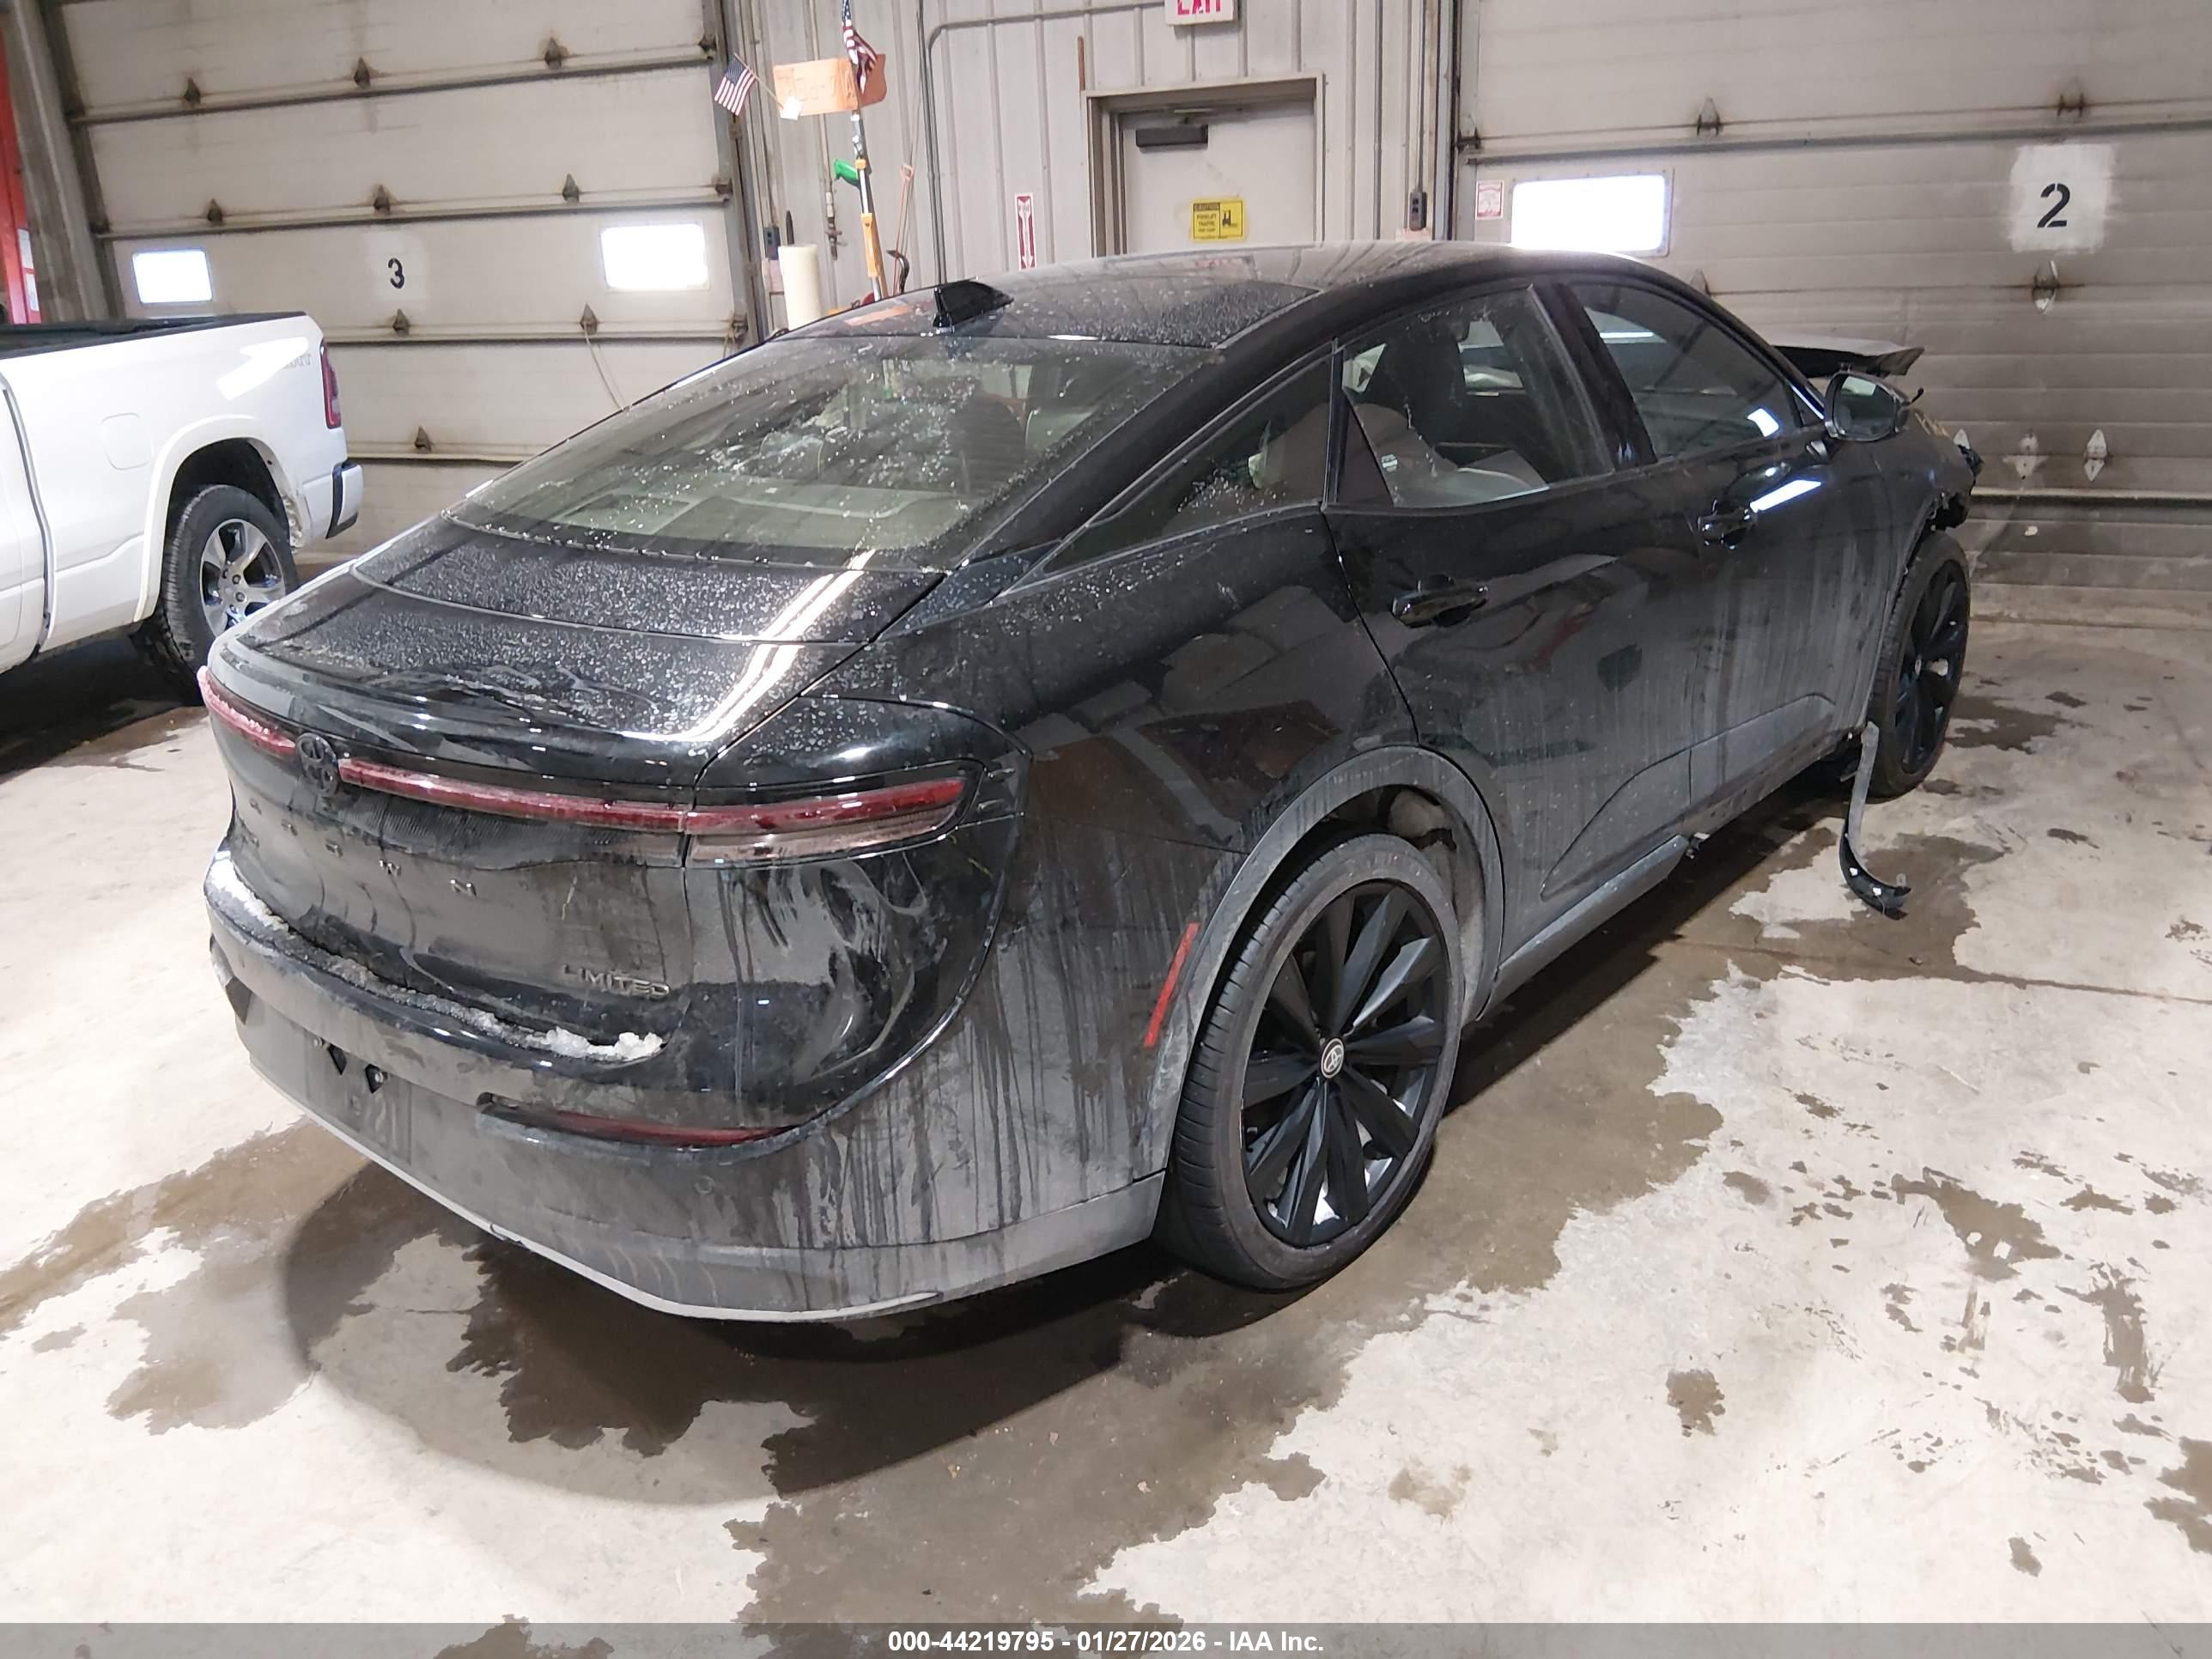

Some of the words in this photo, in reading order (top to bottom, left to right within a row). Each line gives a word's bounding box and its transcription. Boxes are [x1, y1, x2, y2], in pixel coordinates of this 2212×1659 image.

[2037, 183, 2070, 228] 2
[388, 258, 405, 289] 3
[562, 963, 670, 998] LIMITED
